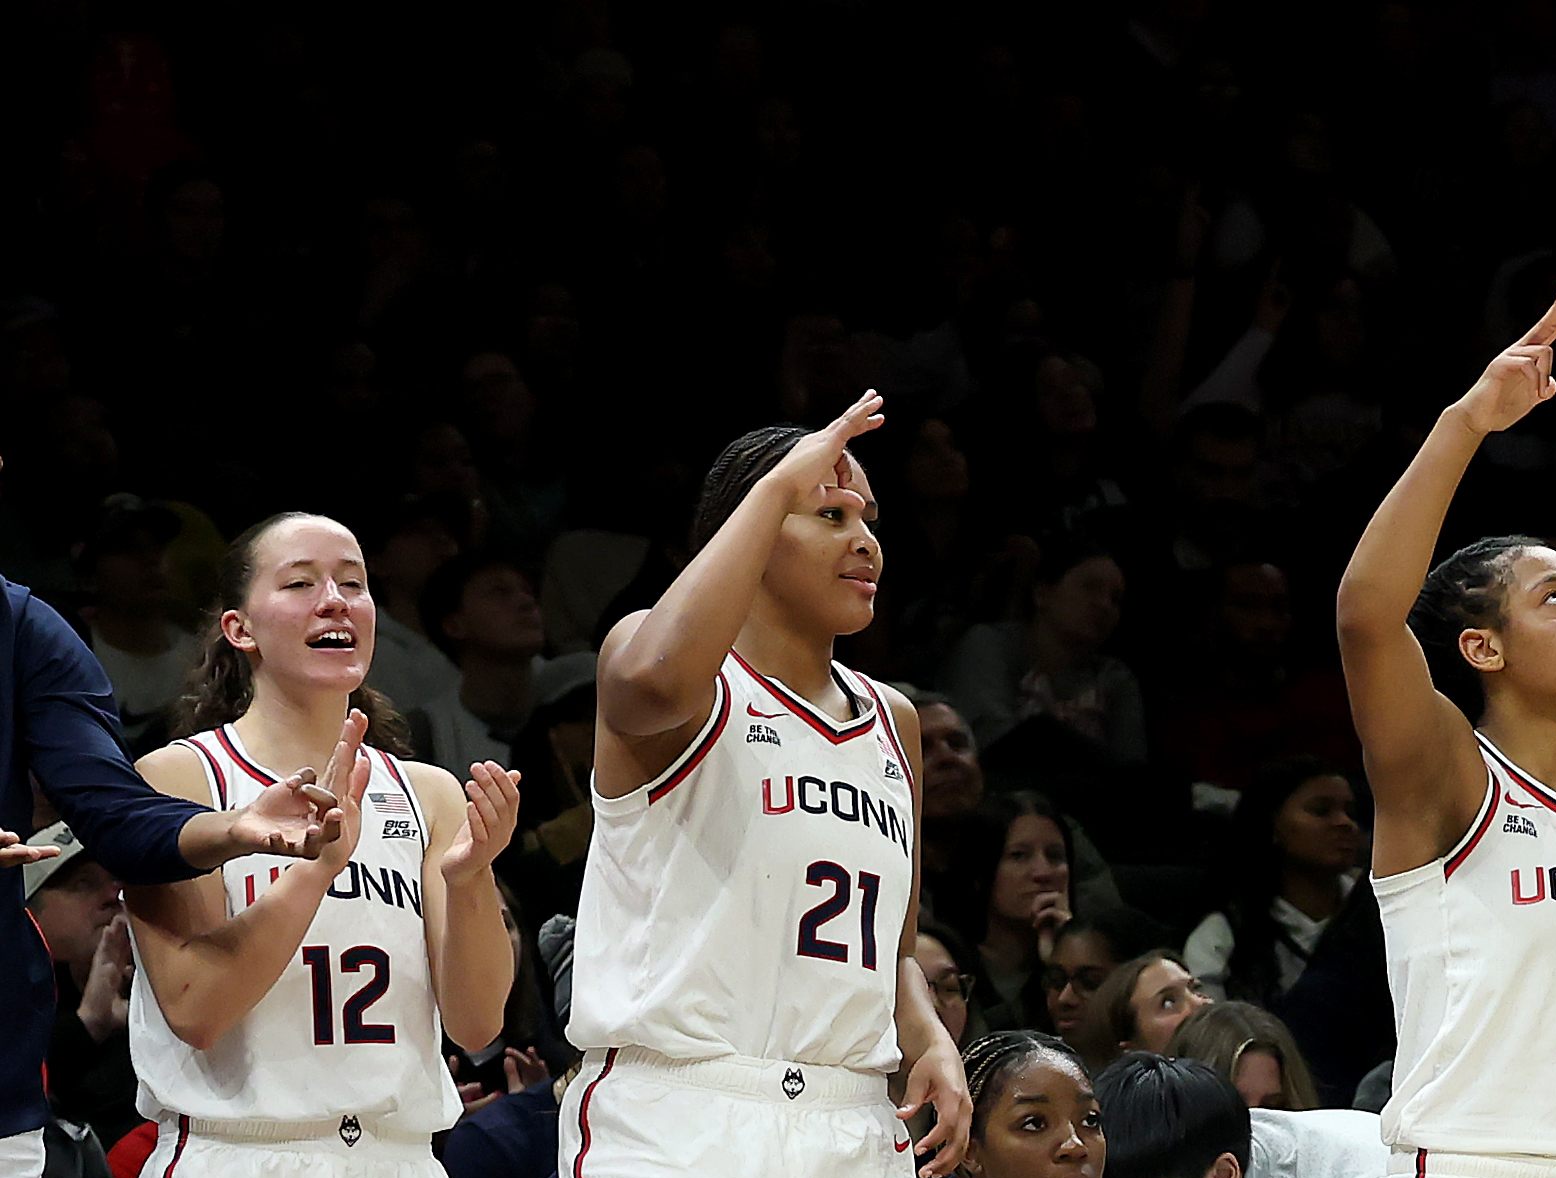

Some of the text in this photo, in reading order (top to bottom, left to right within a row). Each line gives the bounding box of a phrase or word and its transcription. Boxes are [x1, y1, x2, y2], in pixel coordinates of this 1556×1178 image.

[382, 828, 419, 839] EAST
[384, 820, 410, 829] BIG
[762, 775, 909, 858] UCONN
[797, 860, 881, 971] 21
[303, 945, 396, 1045] 12
